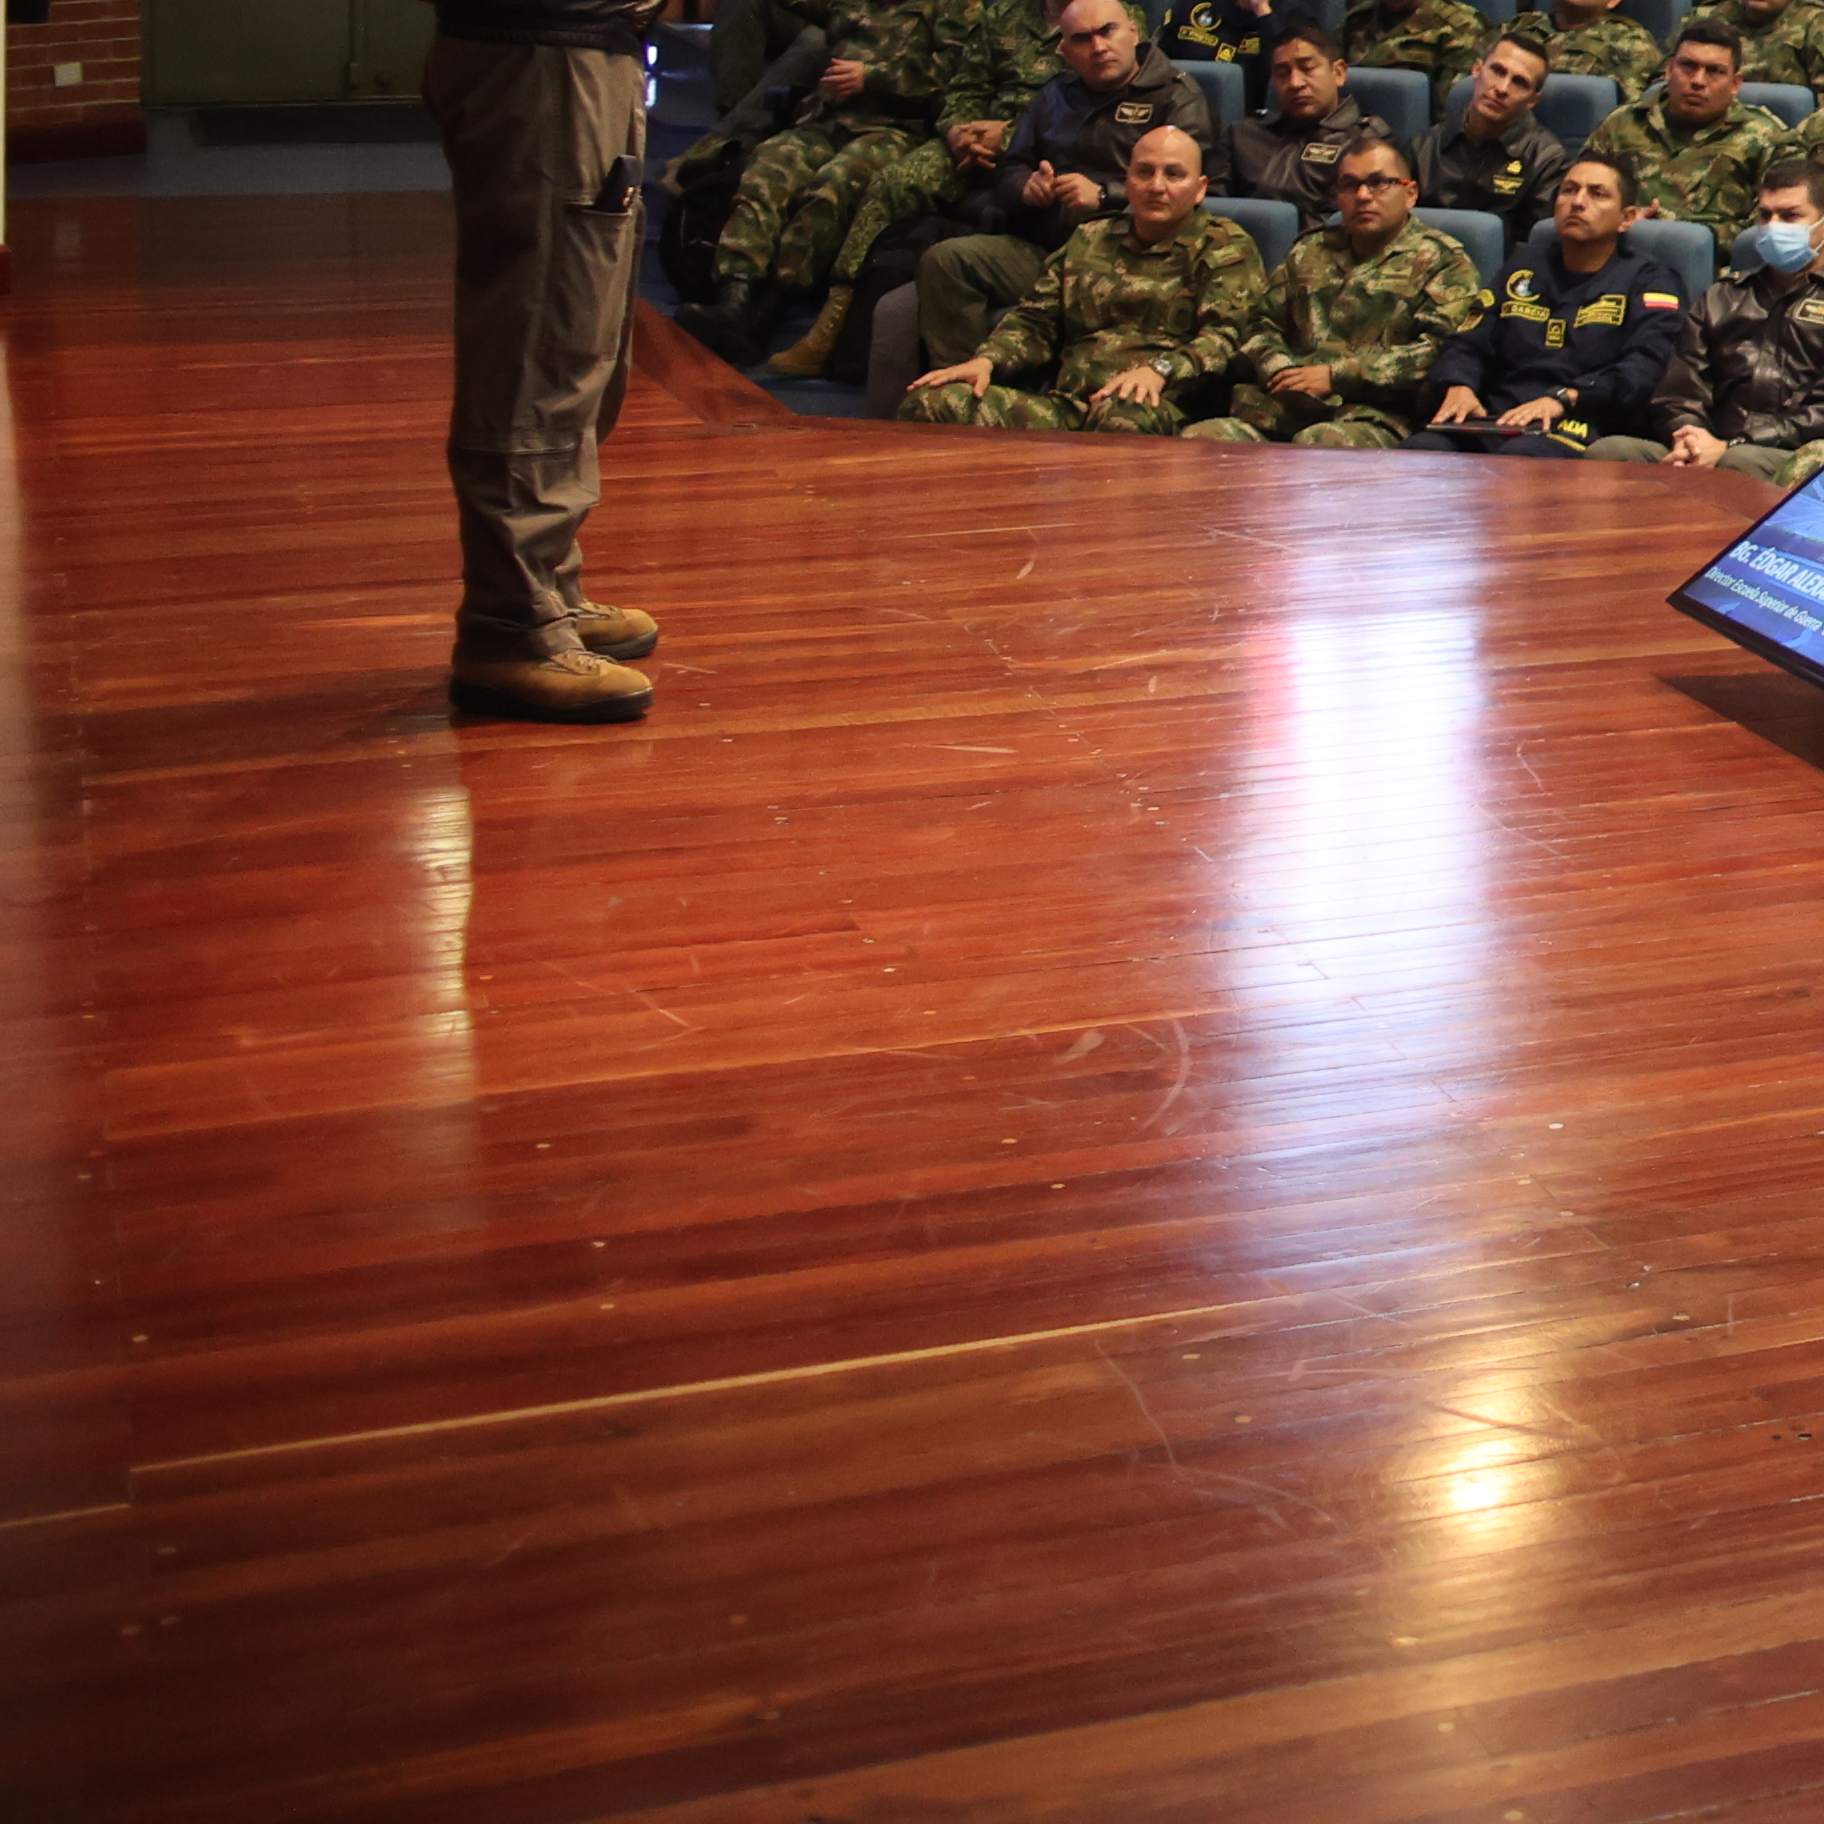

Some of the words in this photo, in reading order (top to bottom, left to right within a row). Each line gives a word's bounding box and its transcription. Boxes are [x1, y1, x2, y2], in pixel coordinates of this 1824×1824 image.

[1728, 540, 1758, 564] BG.
[1749, 546, 1800, 582] ÉDGAR
[1704, 566, 1734, 588] Director
[1730, 578, 1761, 601] Escuela
[1754, 591, 1790, 618] Superior
[1783, 605, 1799, 619] de
[1793, 610, 1823, 632] Guerra
